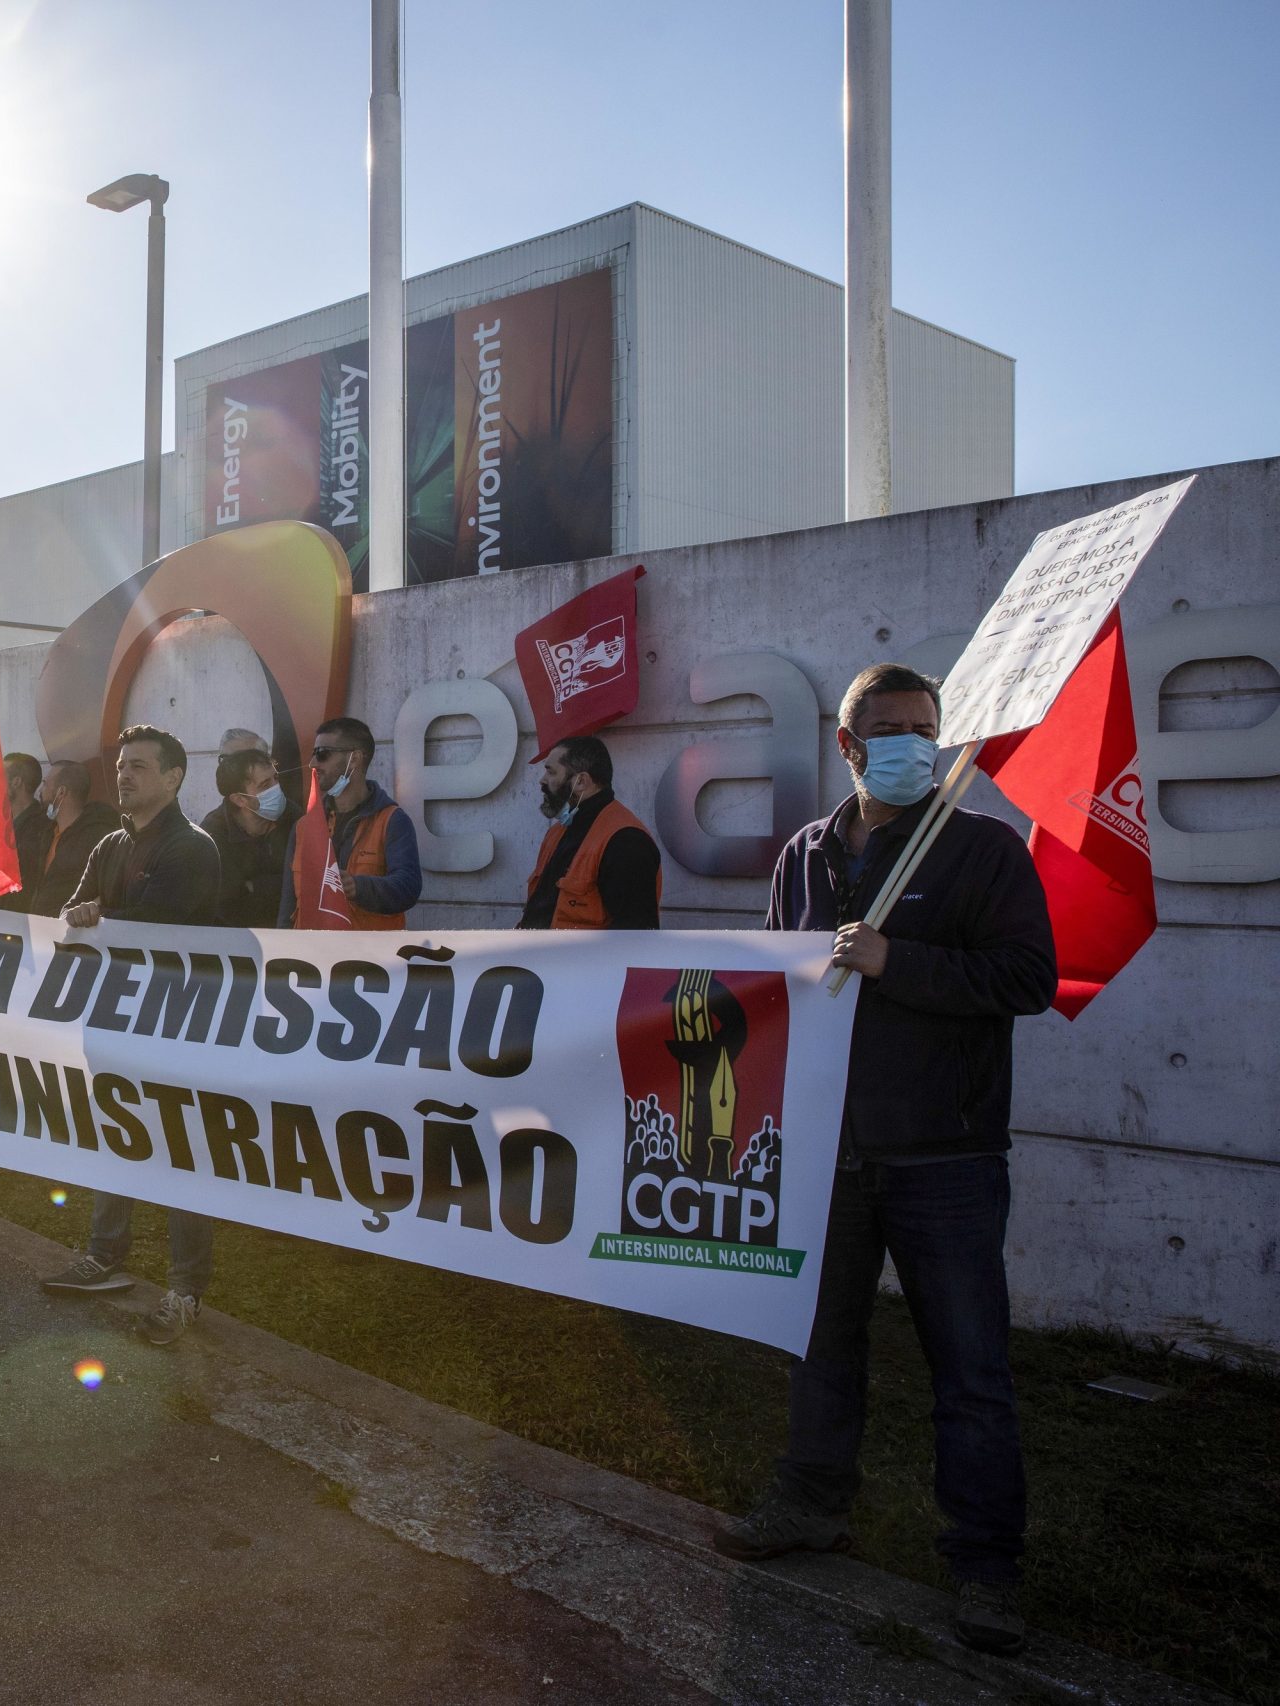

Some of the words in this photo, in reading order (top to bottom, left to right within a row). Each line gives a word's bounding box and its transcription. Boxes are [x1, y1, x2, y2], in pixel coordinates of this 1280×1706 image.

[216, 397, 248, 526] Energy
[332, 364, 368, 526] Mobility
[468, 318, 501, 575] nvironment
[1096, 524, 1113, 537] EM
[1113, 514, 1140, 530] LUTA
[1152, 494, 1170, 505] DA
[1025, 540, 1121, 581] QUEREMOS
[1119, 535, 1136, 550] A
[1081, 550, 1139, 580] DESTA
[28, 941, 545, 1079] DEMISSÃO
[626, 1171, 775, 1243] CGTP
[601, 1238, 713, 1264] INTERSINDICAL
[719, 1249, 793, 1273] NACIONAL
